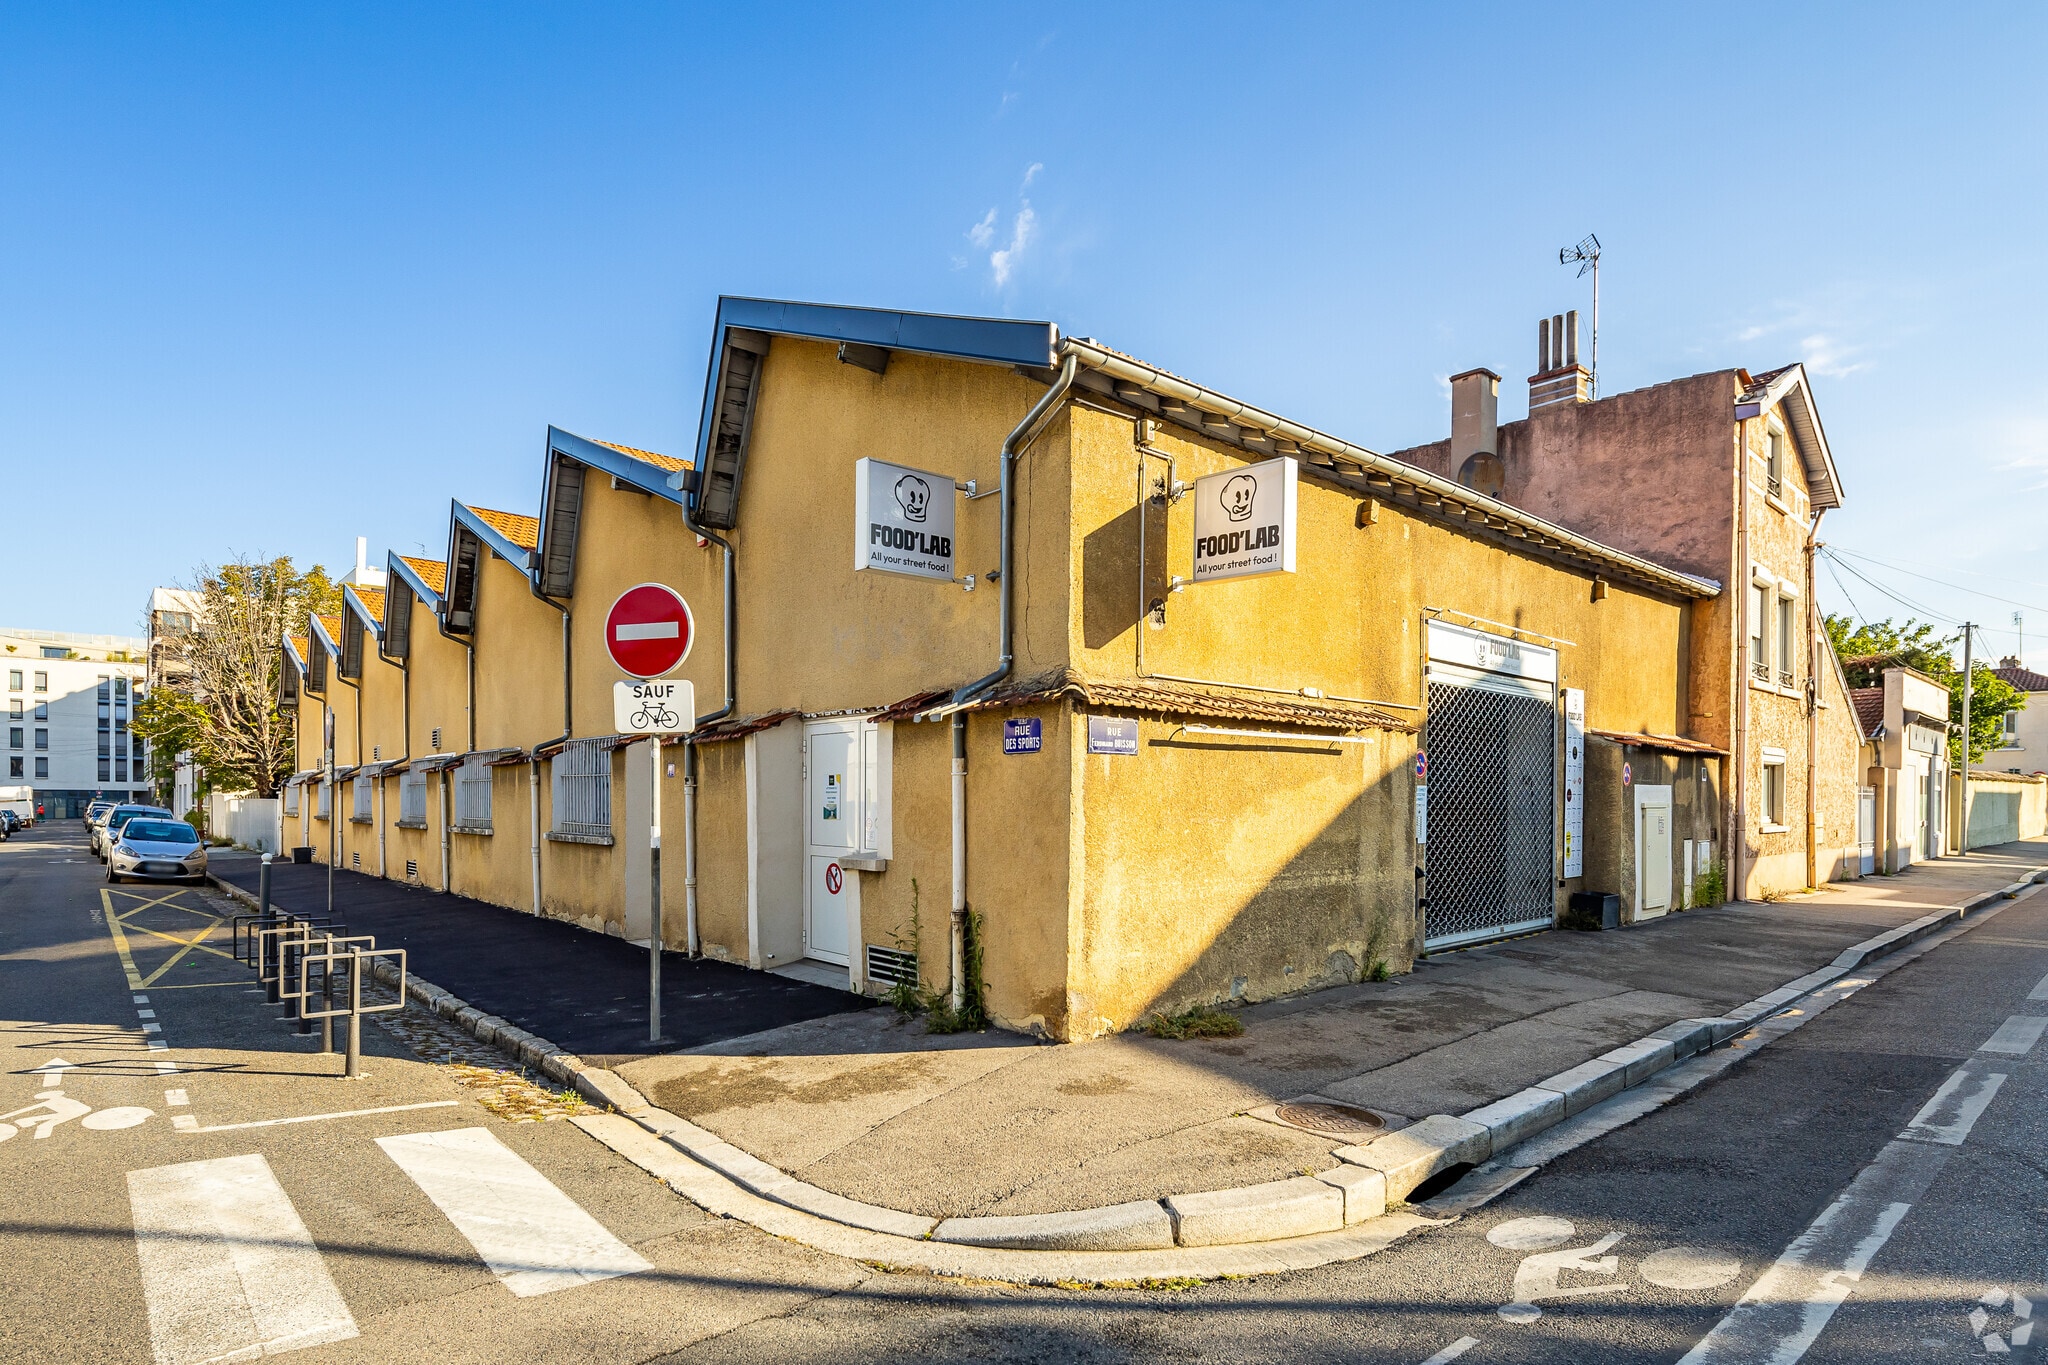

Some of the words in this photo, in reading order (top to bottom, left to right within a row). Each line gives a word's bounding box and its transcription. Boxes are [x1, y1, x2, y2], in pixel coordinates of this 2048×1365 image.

[870, 523, 951, 558] FOOD'LAB
[1197, 524, 1280, 559] FOOD'LAB
[871, 551, 882, 561] All
[883, 554, 901, 564] your
[903, 557, 926, 569] street
[1197, 564, 1207, 574] All
[1208, 562, 1226, 574] your
[1227, 557, 1252, 569] street
[633, 685, 674, 698] SAUF
[1014, 725, 1031, 736] RUE
[1107, 727, 1122, 737] RUE
[1005, 738, 1017, 750] DES
[1018, 737, 1040, 749] SPORTS
